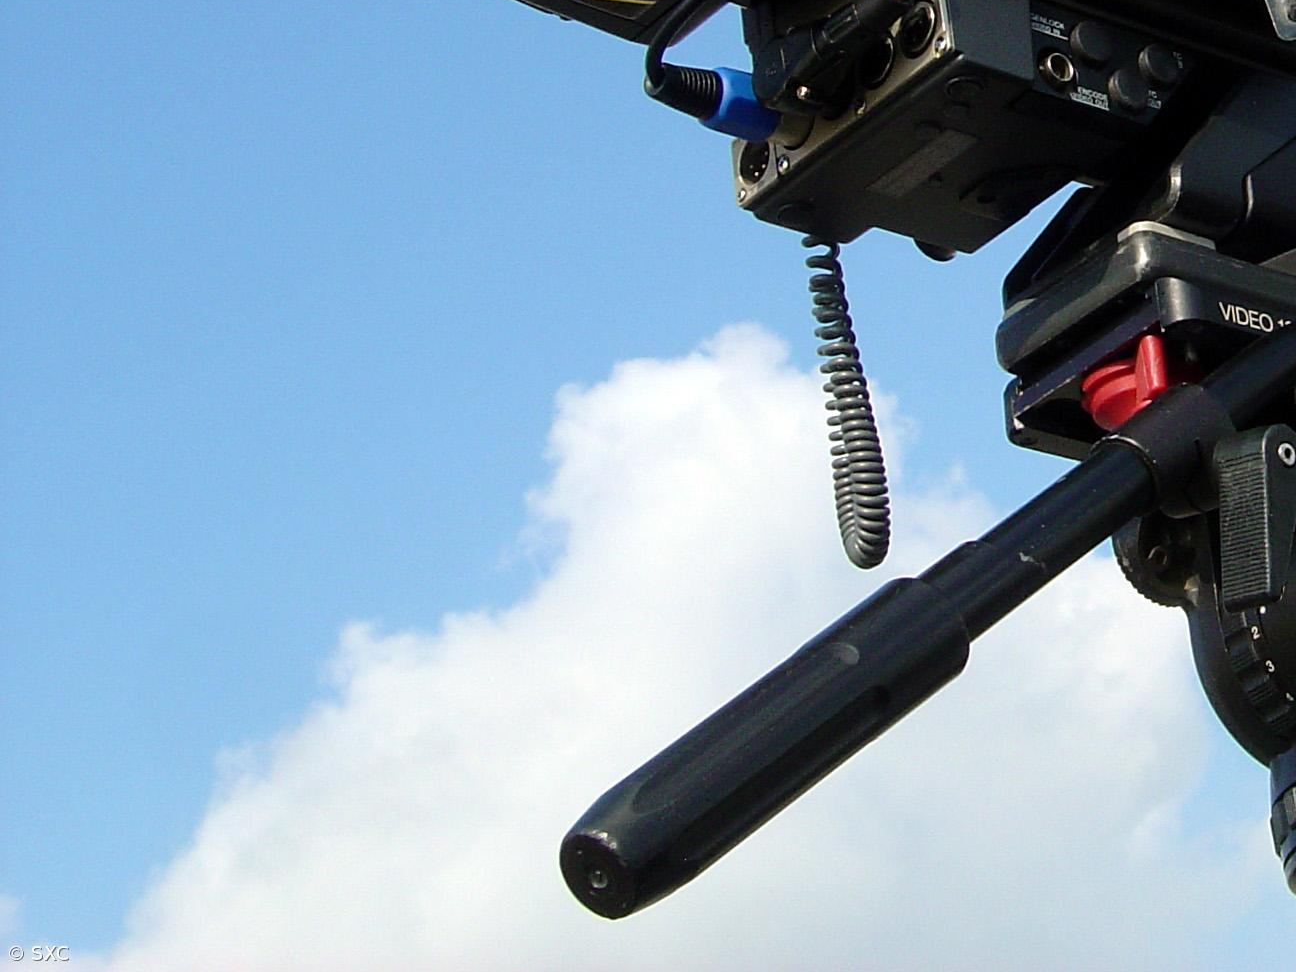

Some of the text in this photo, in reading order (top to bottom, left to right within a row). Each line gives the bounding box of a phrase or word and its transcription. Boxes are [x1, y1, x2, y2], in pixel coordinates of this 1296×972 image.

[1077, 86, 1109, 101] ENCODE
[1218, 301, 1274, 333] VIDEO
[1251, 625, 1275, 673] 2 3
